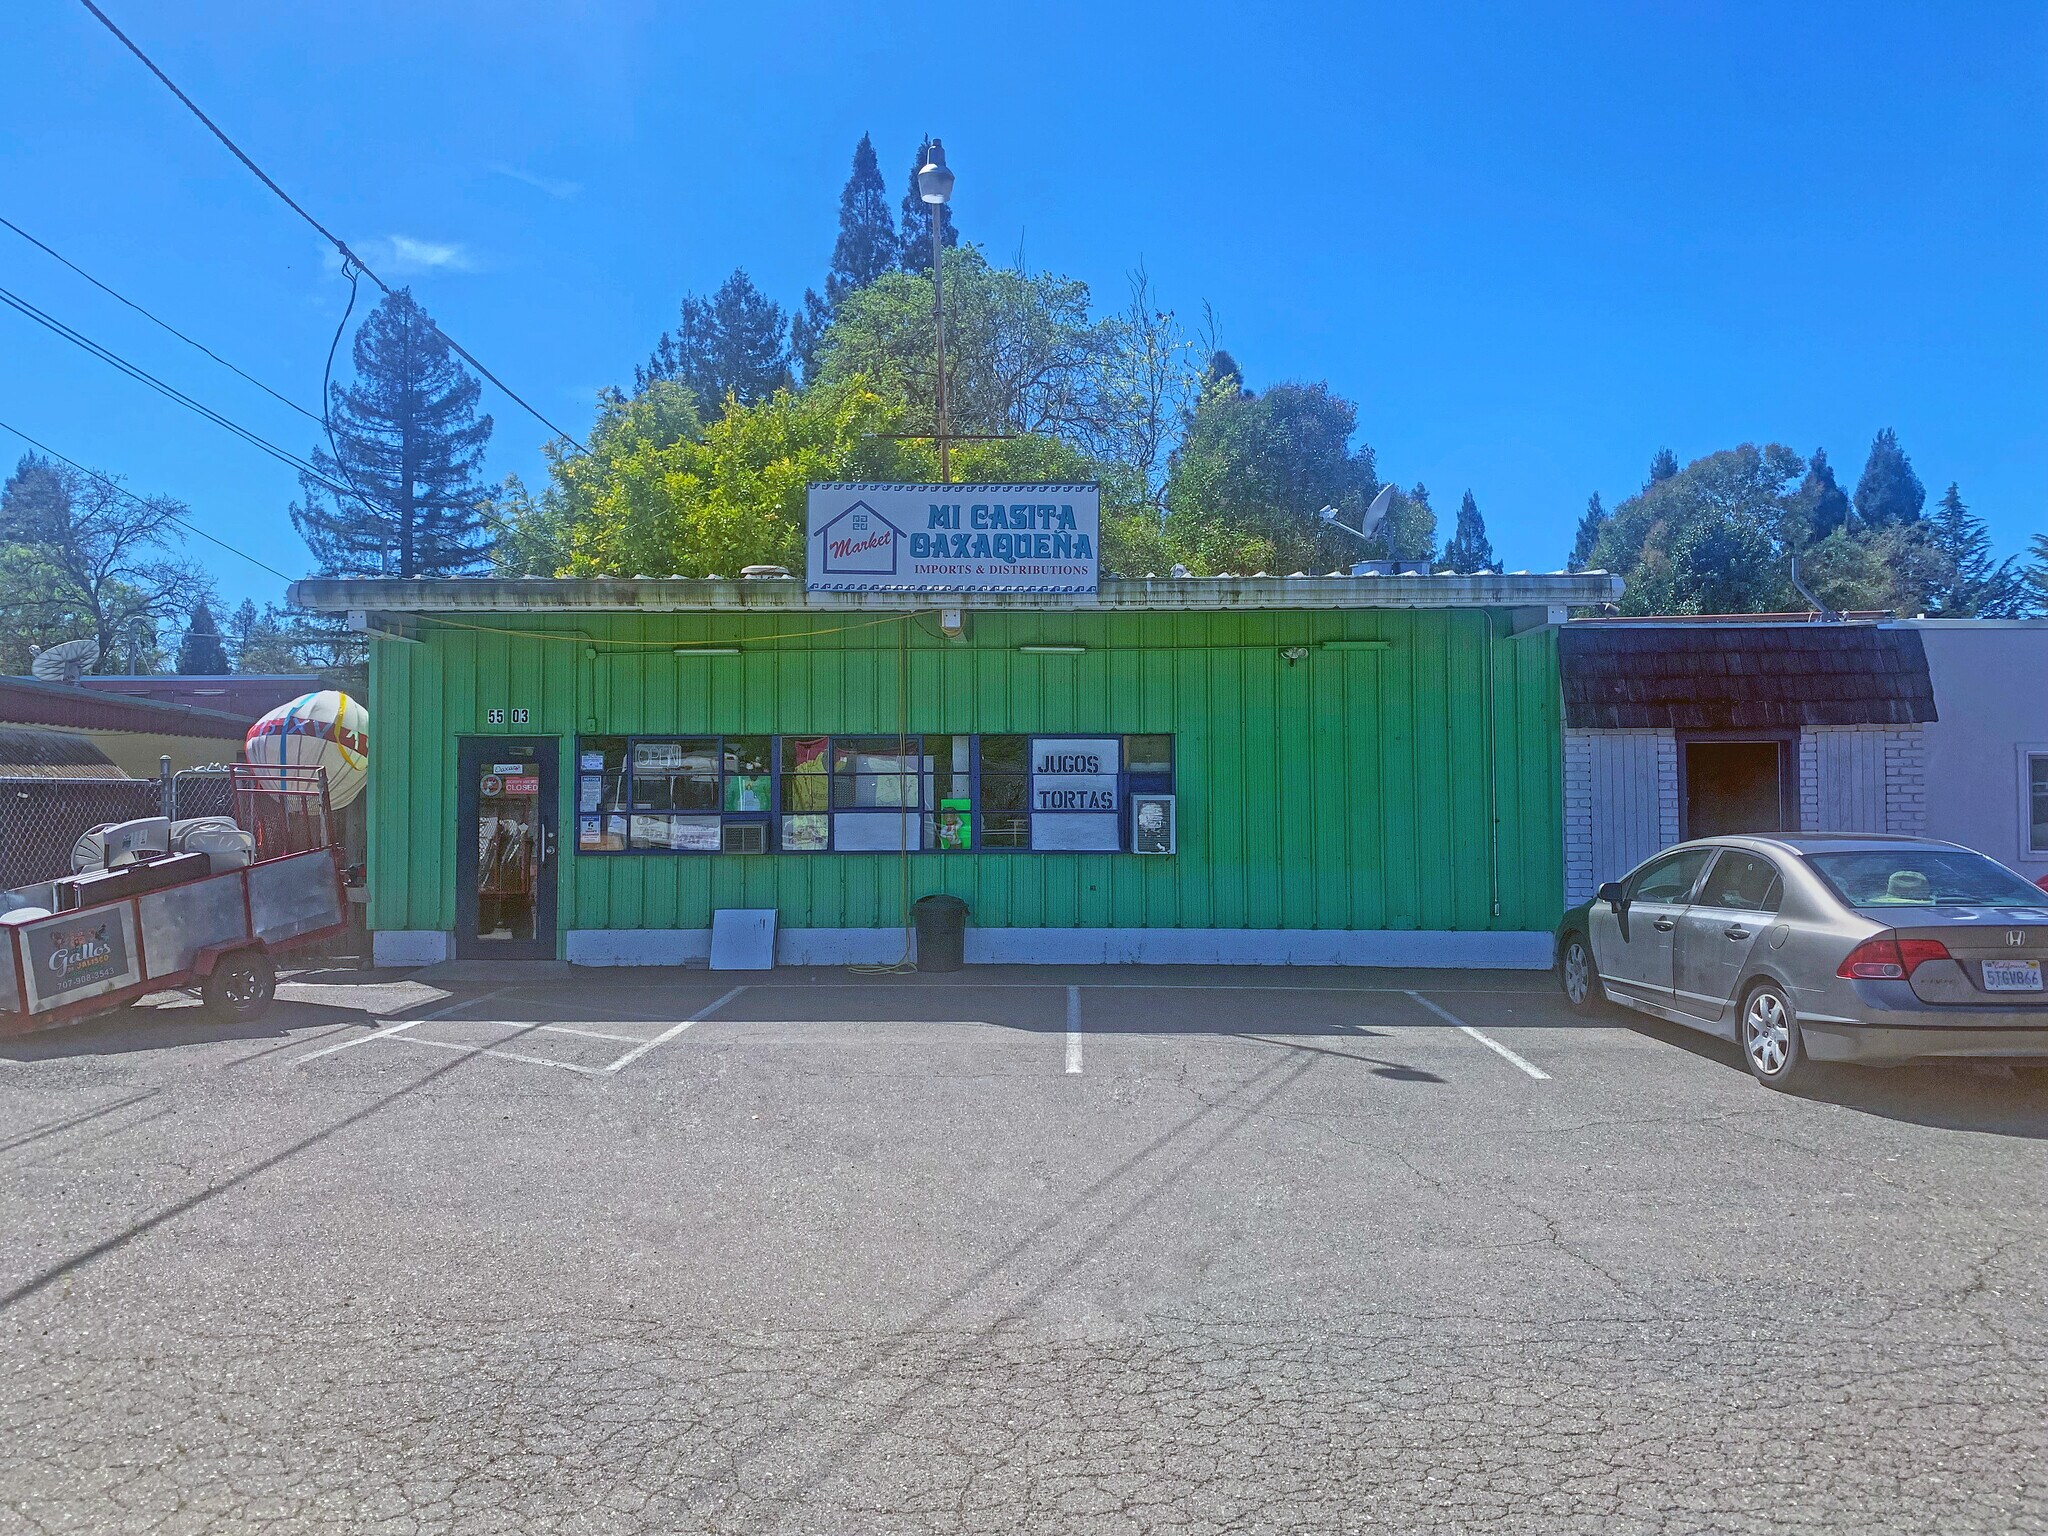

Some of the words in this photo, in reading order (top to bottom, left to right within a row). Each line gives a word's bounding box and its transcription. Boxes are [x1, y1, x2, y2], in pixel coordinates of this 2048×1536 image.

[927, 504, 961, 530] MI
[970, 504, 1078, 531] CASITA
[829, 530, 892, 560] Market
[909, 530, 1093, 564] OAXAQUEÑA
[914, 564, 972, 575] IMPORTS
[975, 565, 985, 575] &
[988, 564, 1089, 576] DISTRIBUTIONS
[638, 746, 680, 766] OPEN
[1037, 755, 1099, 773] JUGOS
[1039, 791, 1113, 809] TORTAS
[49, 942, 111, 977] Gallos
[76, 954, 109, 970] JALISCO
[57, 967, 115, 990] 707-908-3543
[1986, 970, 2039, 985] 5TGV866
